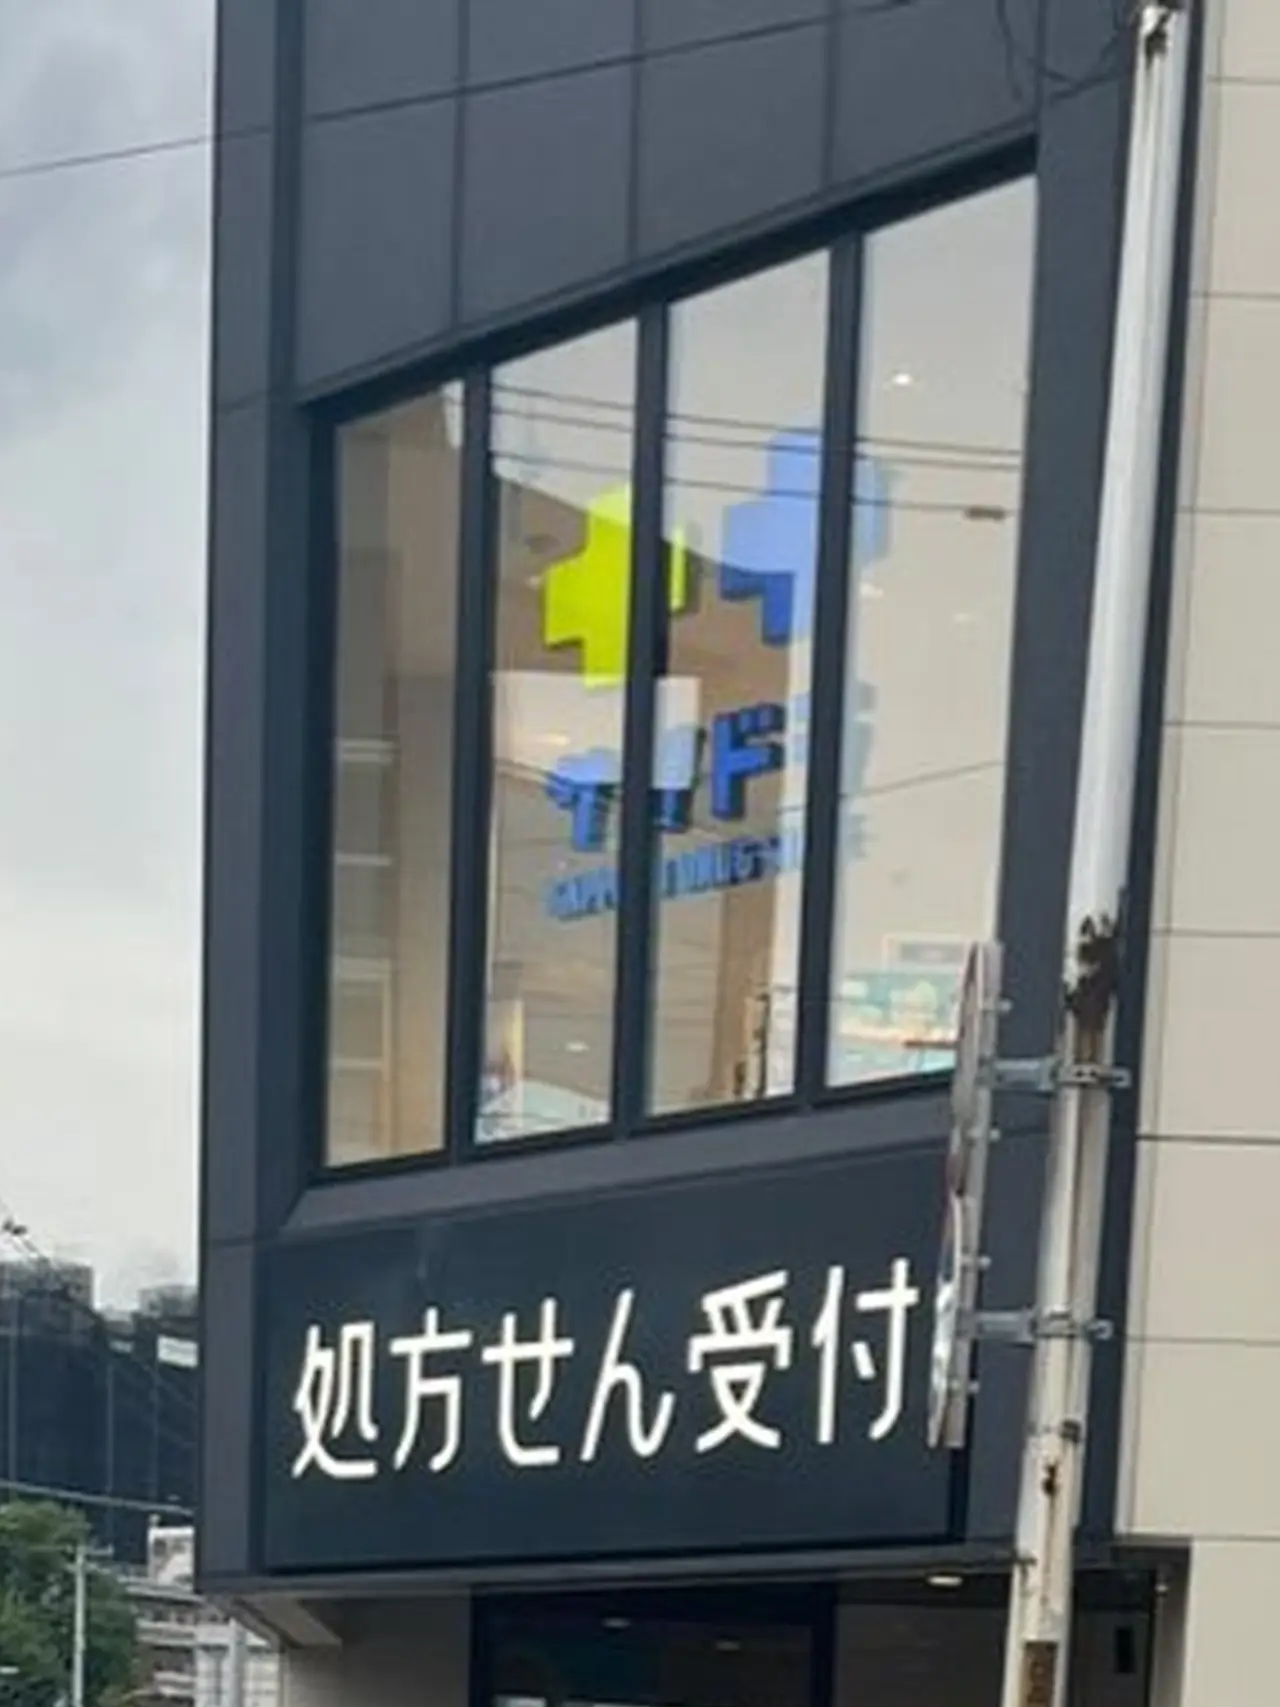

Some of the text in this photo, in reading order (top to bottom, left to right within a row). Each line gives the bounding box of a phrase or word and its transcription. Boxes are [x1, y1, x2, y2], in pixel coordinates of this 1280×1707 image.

[292, 1257, 920, 1480] 処方せん受付
